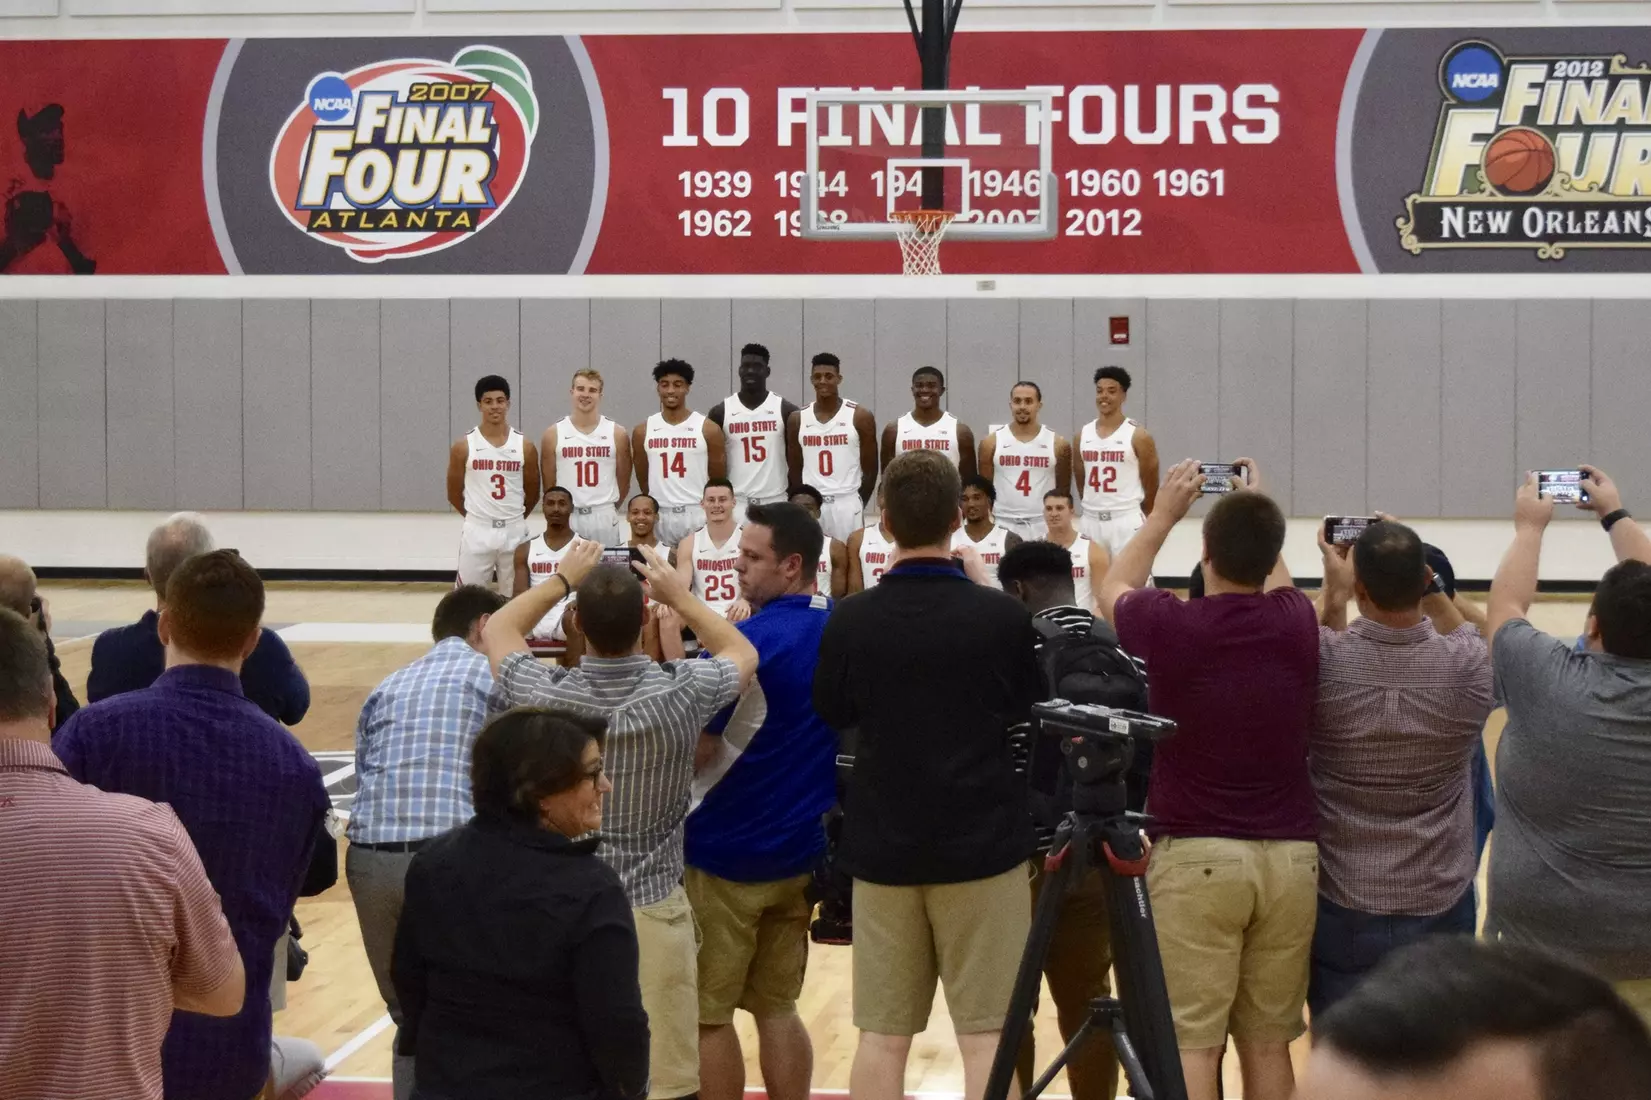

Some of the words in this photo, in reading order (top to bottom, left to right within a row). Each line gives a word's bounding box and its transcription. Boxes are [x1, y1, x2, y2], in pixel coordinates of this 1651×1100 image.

[1452, 73, 1499, 88] NCAA
[1553, 60, 1604, 78] 2012
[409, 83, 490, 101] 2007
[1498, 64, 1651, 126] FINA
[313, 98, 353, 111] NCAA
[662, 87, 750, 147] 10
[1025, 84, 1280, 145] FOURS
[354, 93, 493, 145] FINAL
[300, 129, 492, 206] FOUR
[678, 170, 752, 198] 1939
[870, 170, 923, 198] 194
[969, 169, 1041, 198] 1946
[1065, 168, 1141, 197] 1960
[1152, 168, 1225, 197] 1961
[312, 210, 473, 229] ATLANTA
[678, 209, 752, 237] 1962
[774, 209, 848, 237] 198
[1065, 208, 1142, 236] 2012
[1440, 206, 1513, 238] NEW
[729, 421, 750, 434] OHIO
[752, 420, 778, 432] STATE
[648, 437, 668, 449] OHIO
[671, 437, 697, 448] STATE
[740, 435, 767, 463] 15
[803, 435, 822, 446] OHIO
[823, 434, 849, 446] STATE
[902, 439, 922, 450] OHIO
[925, 439, 950, 451] STATE
[562, 446, 584, 458] OHIO
[585, 446, 611, 458] STATE
[818, 450, 834, 477] 0
[1000, 455, 1021, 467] OHIO
[1023, 456, 1050, 468] STATE
[1082, 450, 1098, 462] OHIO
[1100, 450, 1125, 462] STATE
[472, 459, 494, 471] OHIO
[496, 460, 521, 472] STATE
[574, 461, 599, 488] 10
[659, 452, 687, 479] 14
[490, 473, 506, 500] 3
[1015, 470, 1032, 497] 4
[1088, 466, 1117, 493] 42
[531, 562, 552, 573] OHIO
[697, 559, 717, 571] OHIO
[866, 552, 886, 564] OHIO
[705, 574, 735, 601] 25
[1133, 876, 1147, 919] sachtler
